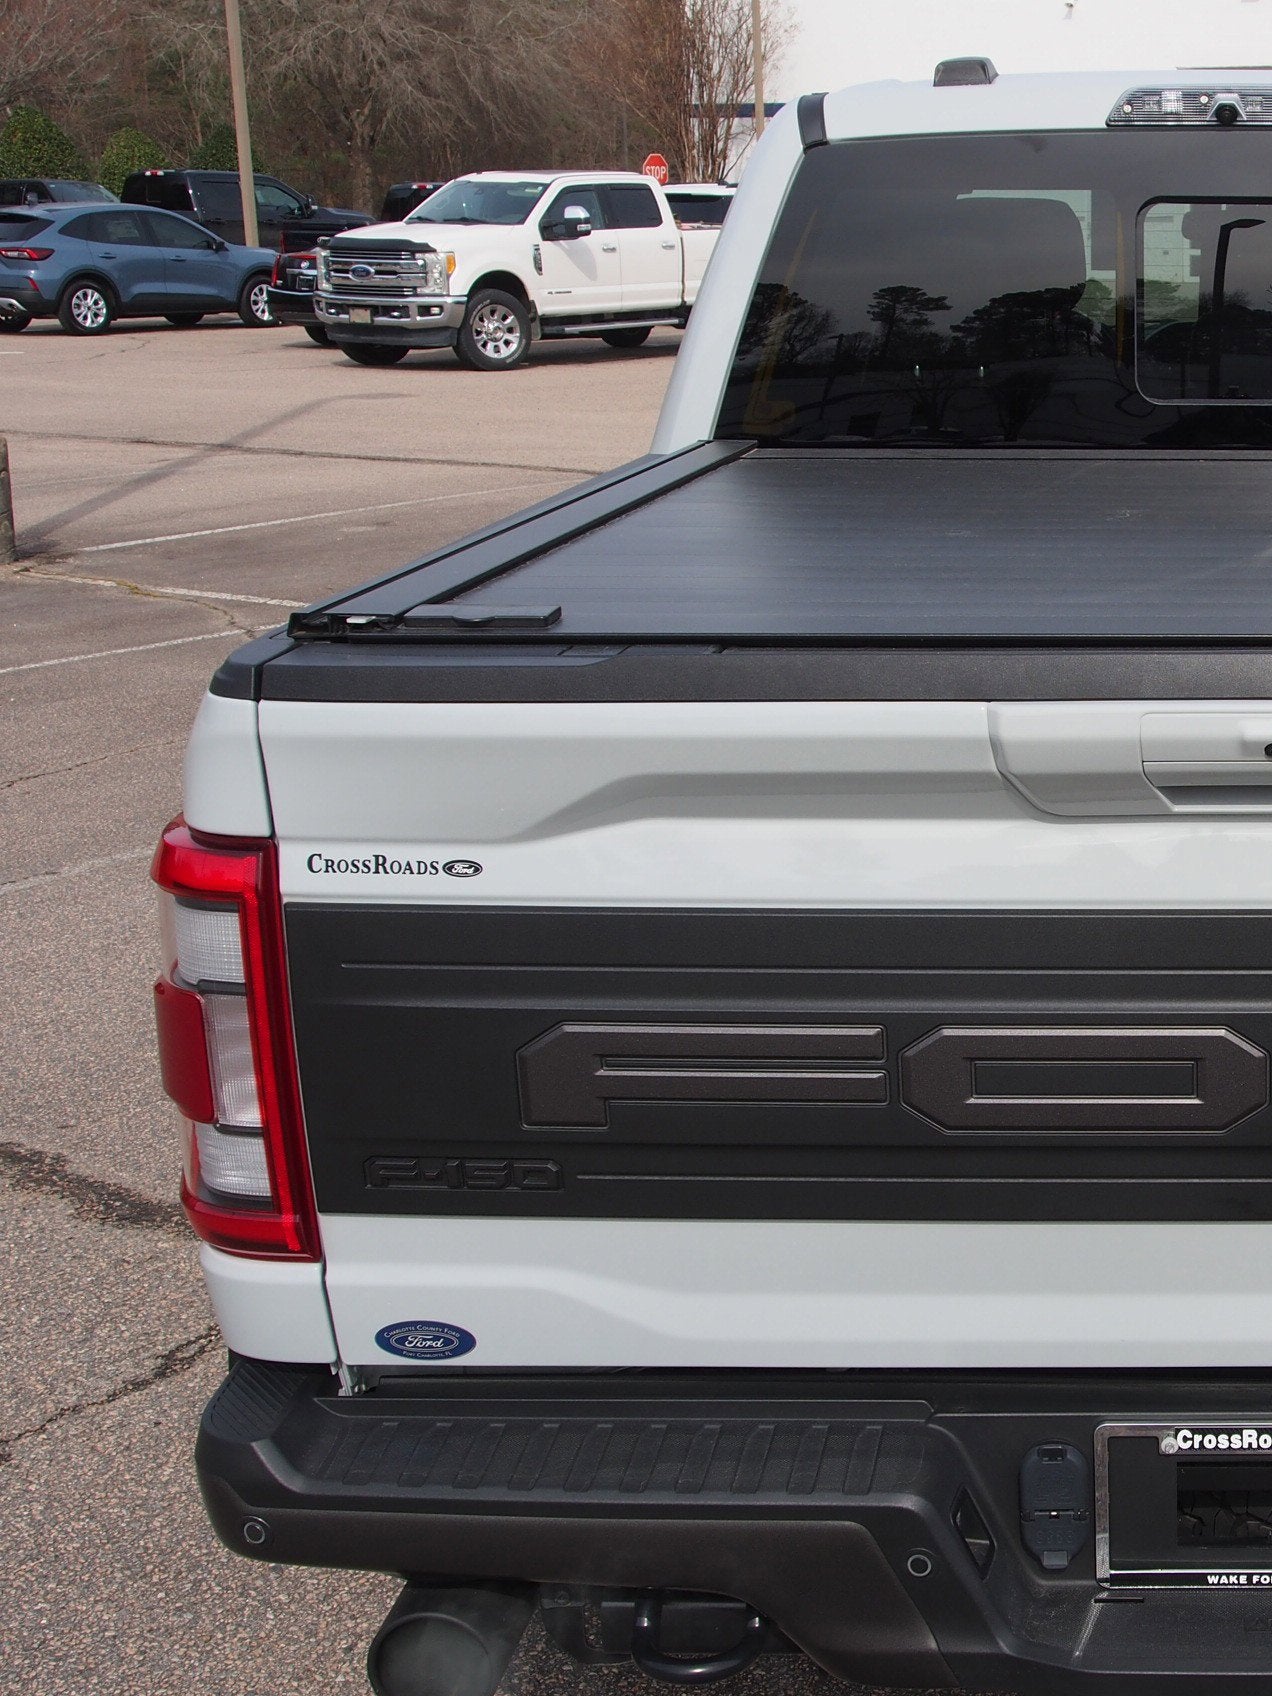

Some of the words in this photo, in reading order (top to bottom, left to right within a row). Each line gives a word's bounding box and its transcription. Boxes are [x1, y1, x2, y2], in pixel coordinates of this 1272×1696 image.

[645, 165, 667, 180] STOP
[451, 864, 475, 874] Ford
[363, 1156, 565, 1192] F-150
[405, 1335, 444, 1348] Ford
[1207, 1574, 1248, 1584] WAKE
